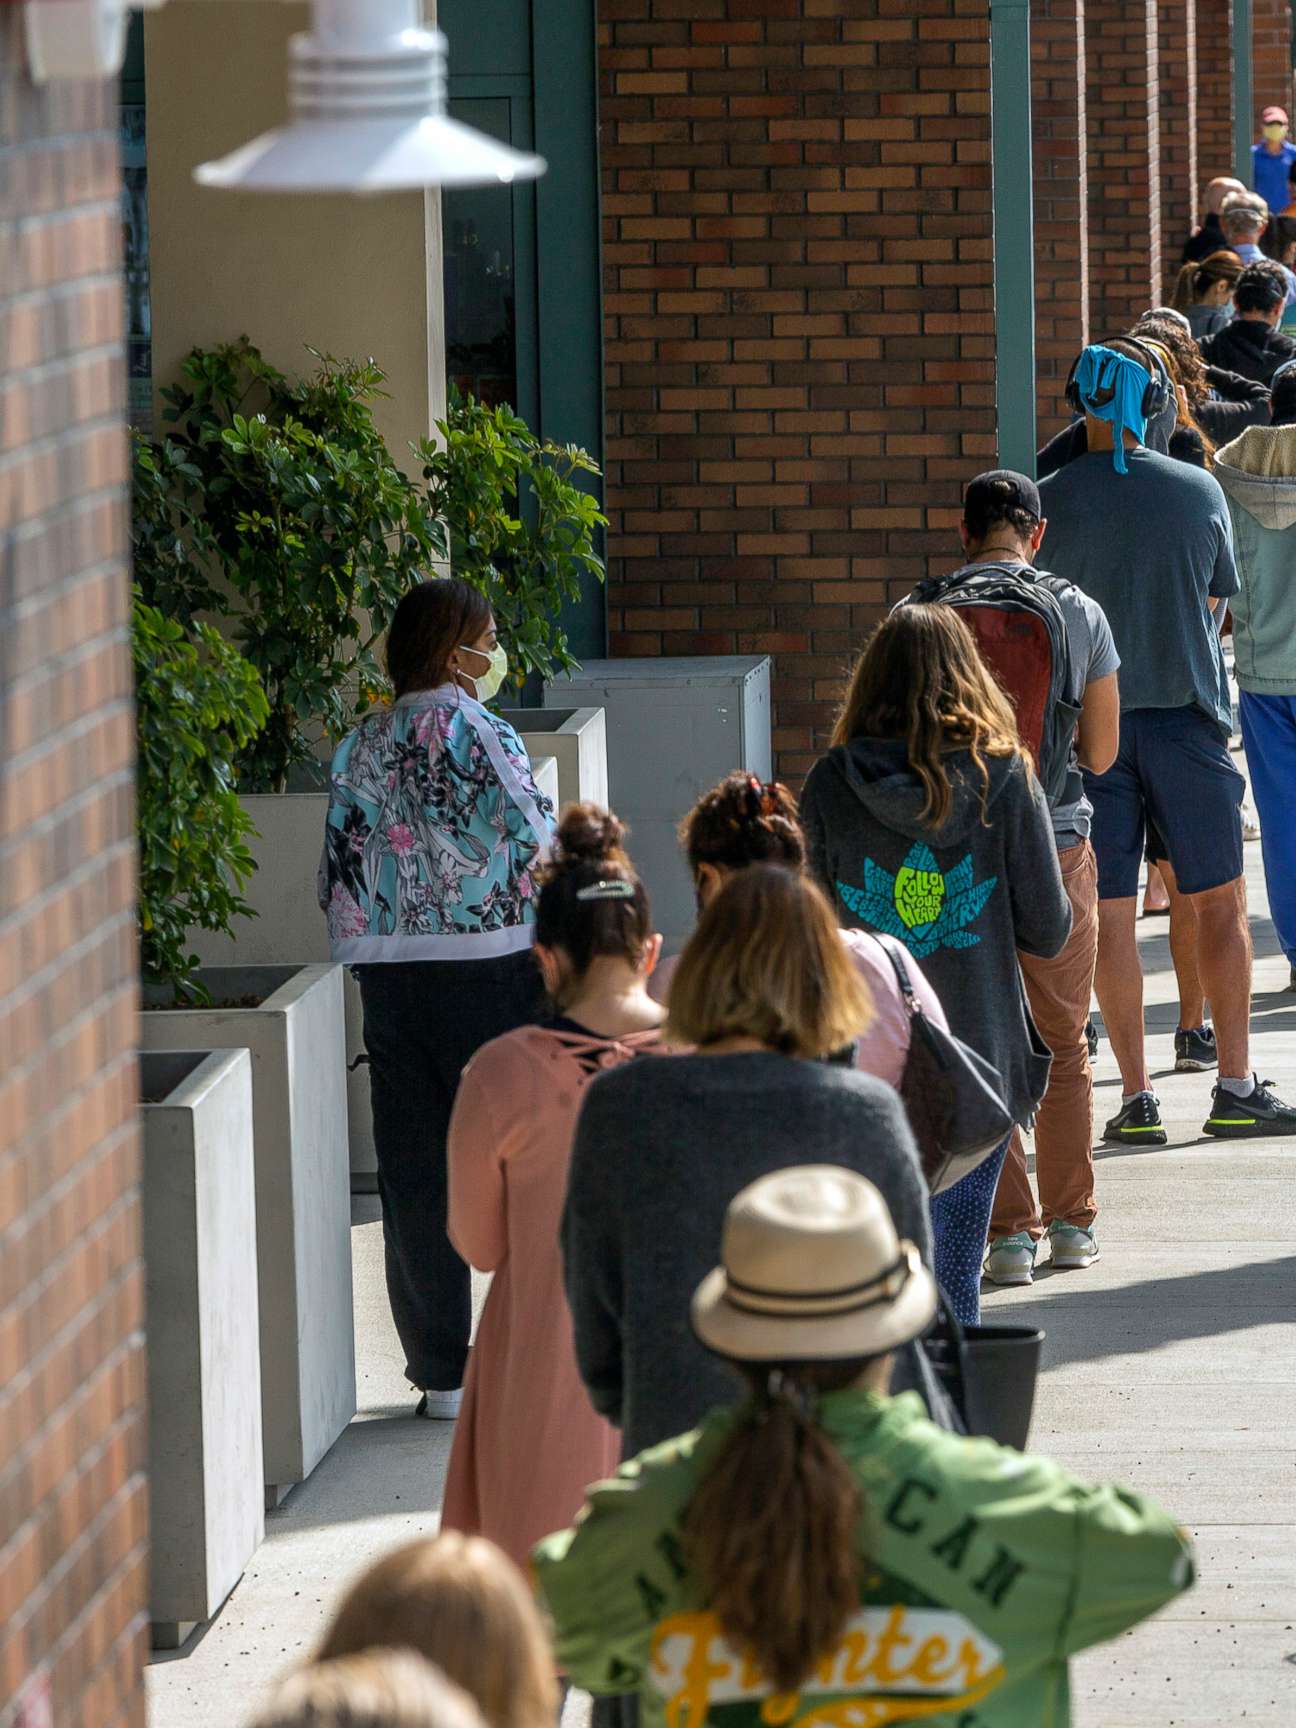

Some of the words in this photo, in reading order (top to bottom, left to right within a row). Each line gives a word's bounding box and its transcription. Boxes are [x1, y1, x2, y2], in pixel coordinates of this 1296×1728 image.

[895, 866, 945, 899] FOLLOW
[895, 898, 942, 929] HEART
[903, 893, 942, 910] YOUR
